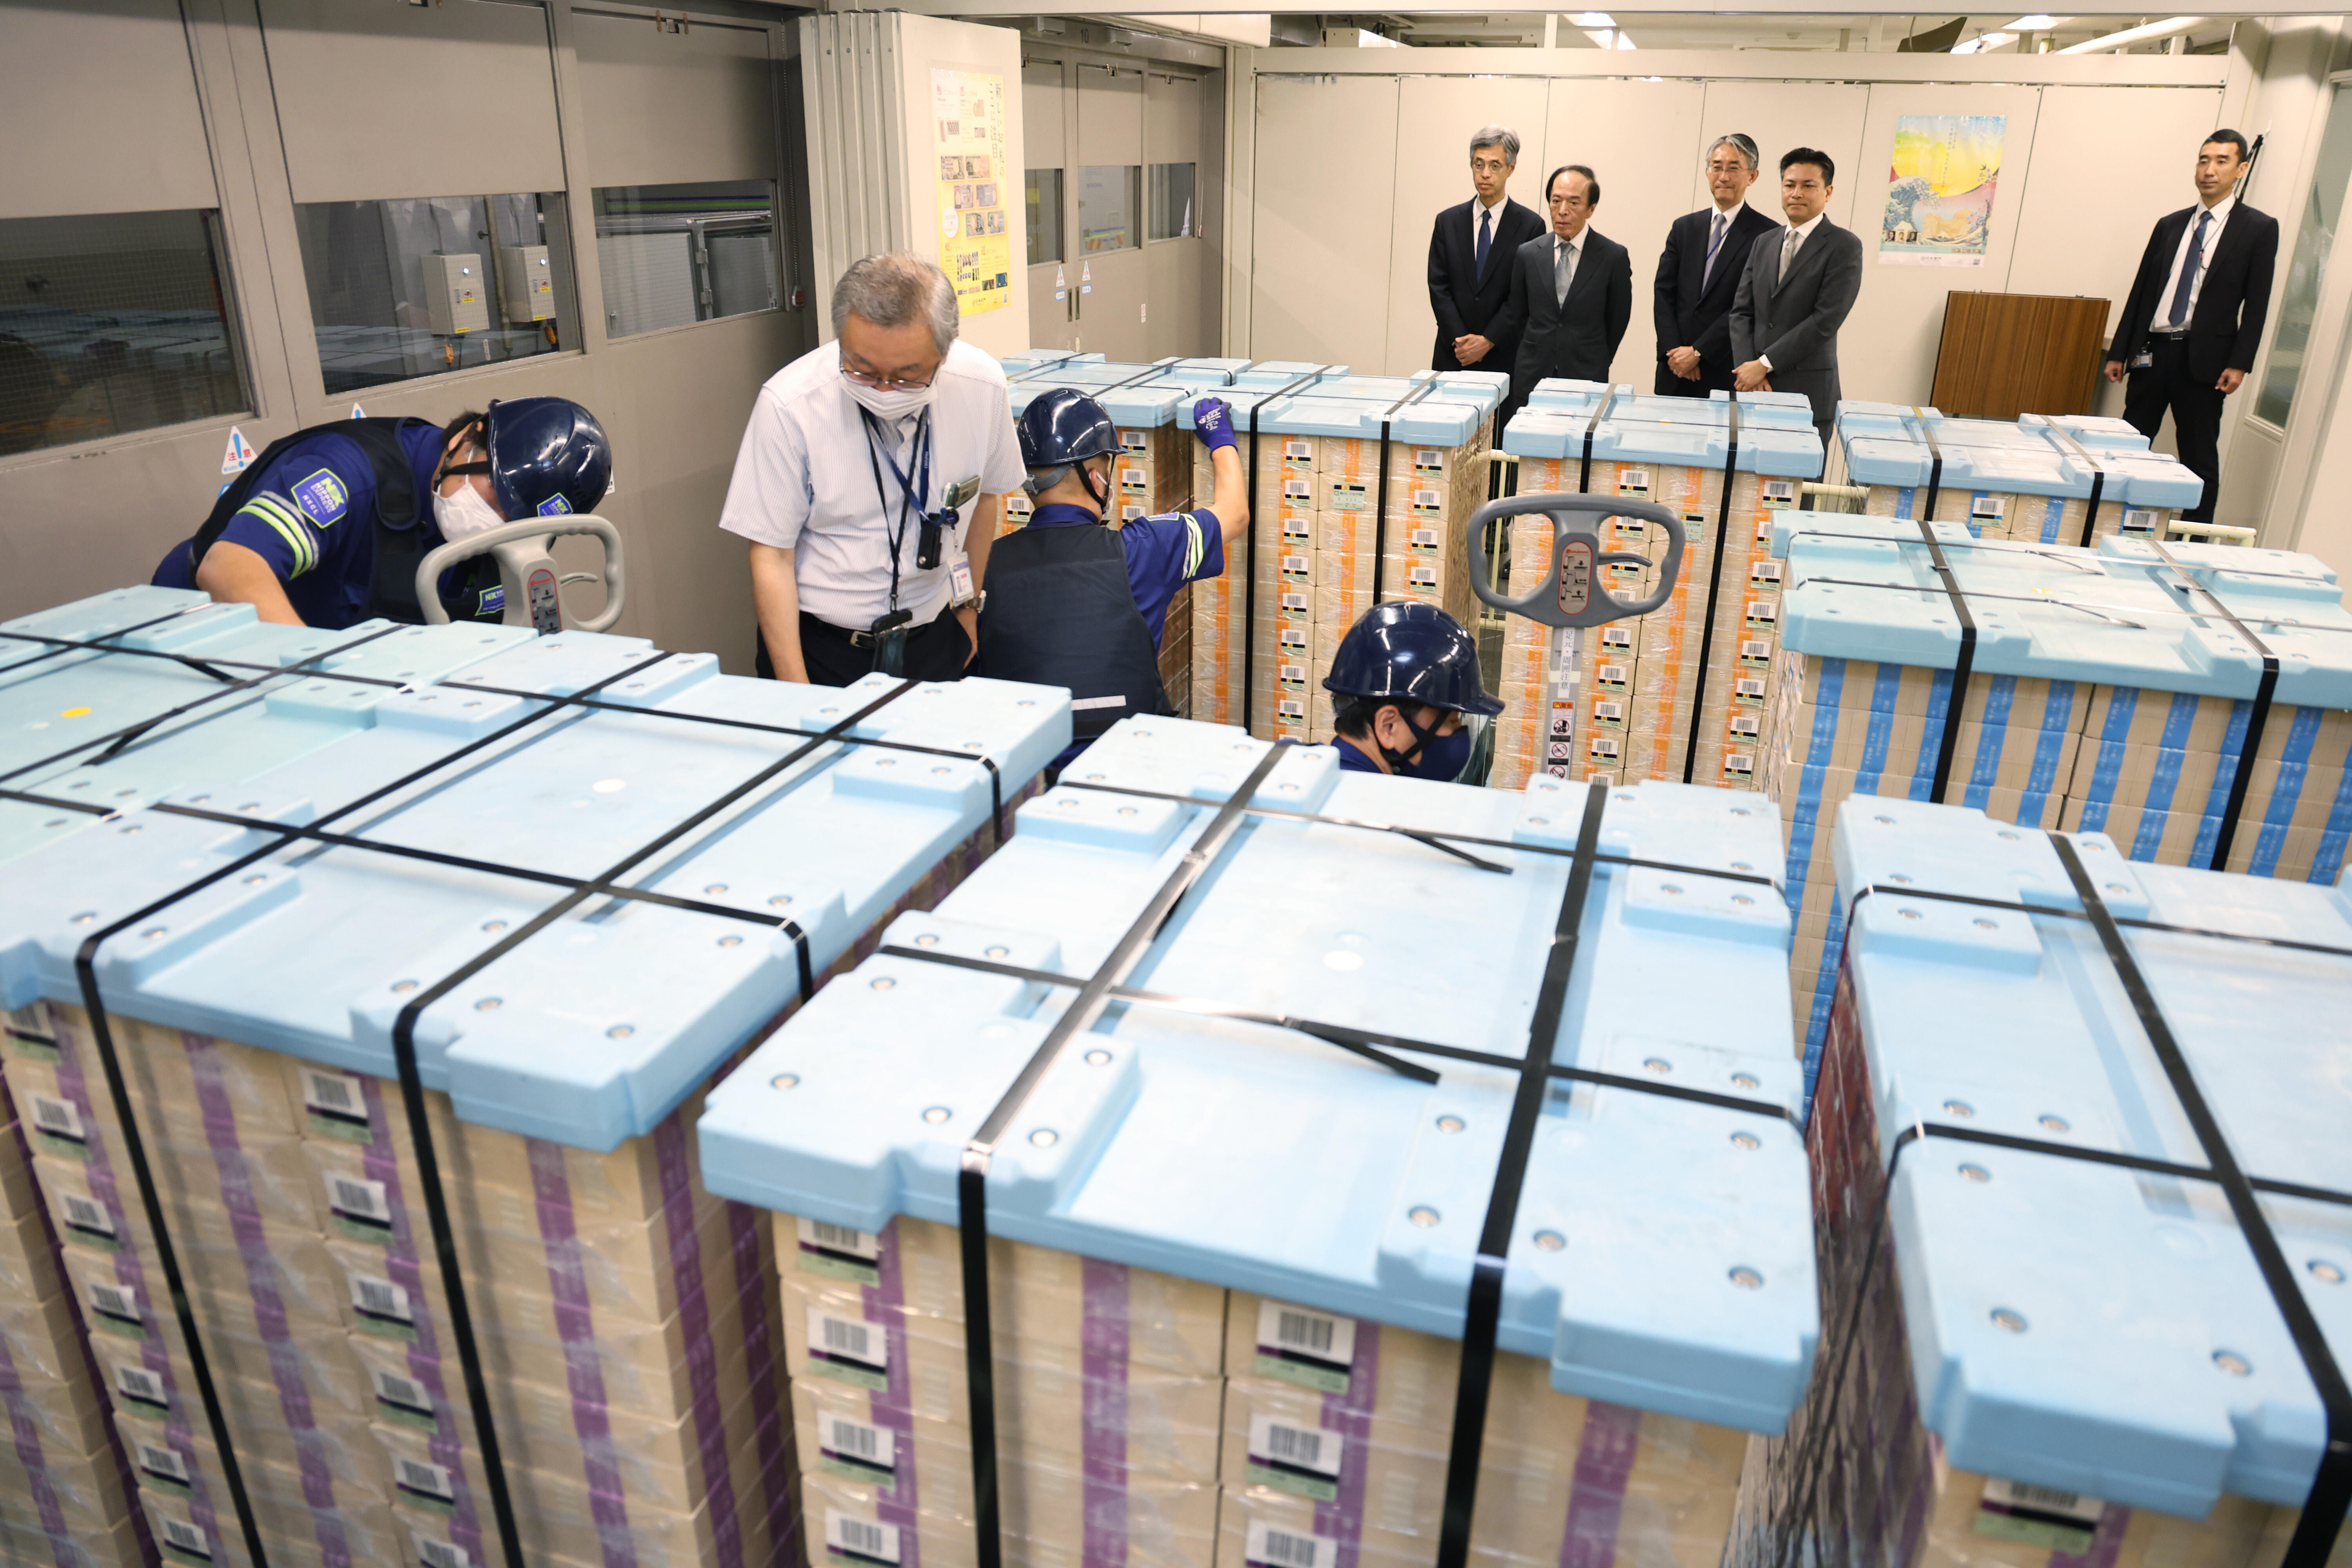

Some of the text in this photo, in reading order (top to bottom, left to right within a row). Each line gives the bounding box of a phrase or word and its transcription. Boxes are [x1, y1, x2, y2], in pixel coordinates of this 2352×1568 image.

[302, 494, 318, 515] NXCL
[310, 485, 331, 513] EXPRESS
[315, 483, 336, 511] NIPPON
[320, 477, 344, 508] NX
[1560, 631, 1573, 689] 足元・周囲注意
